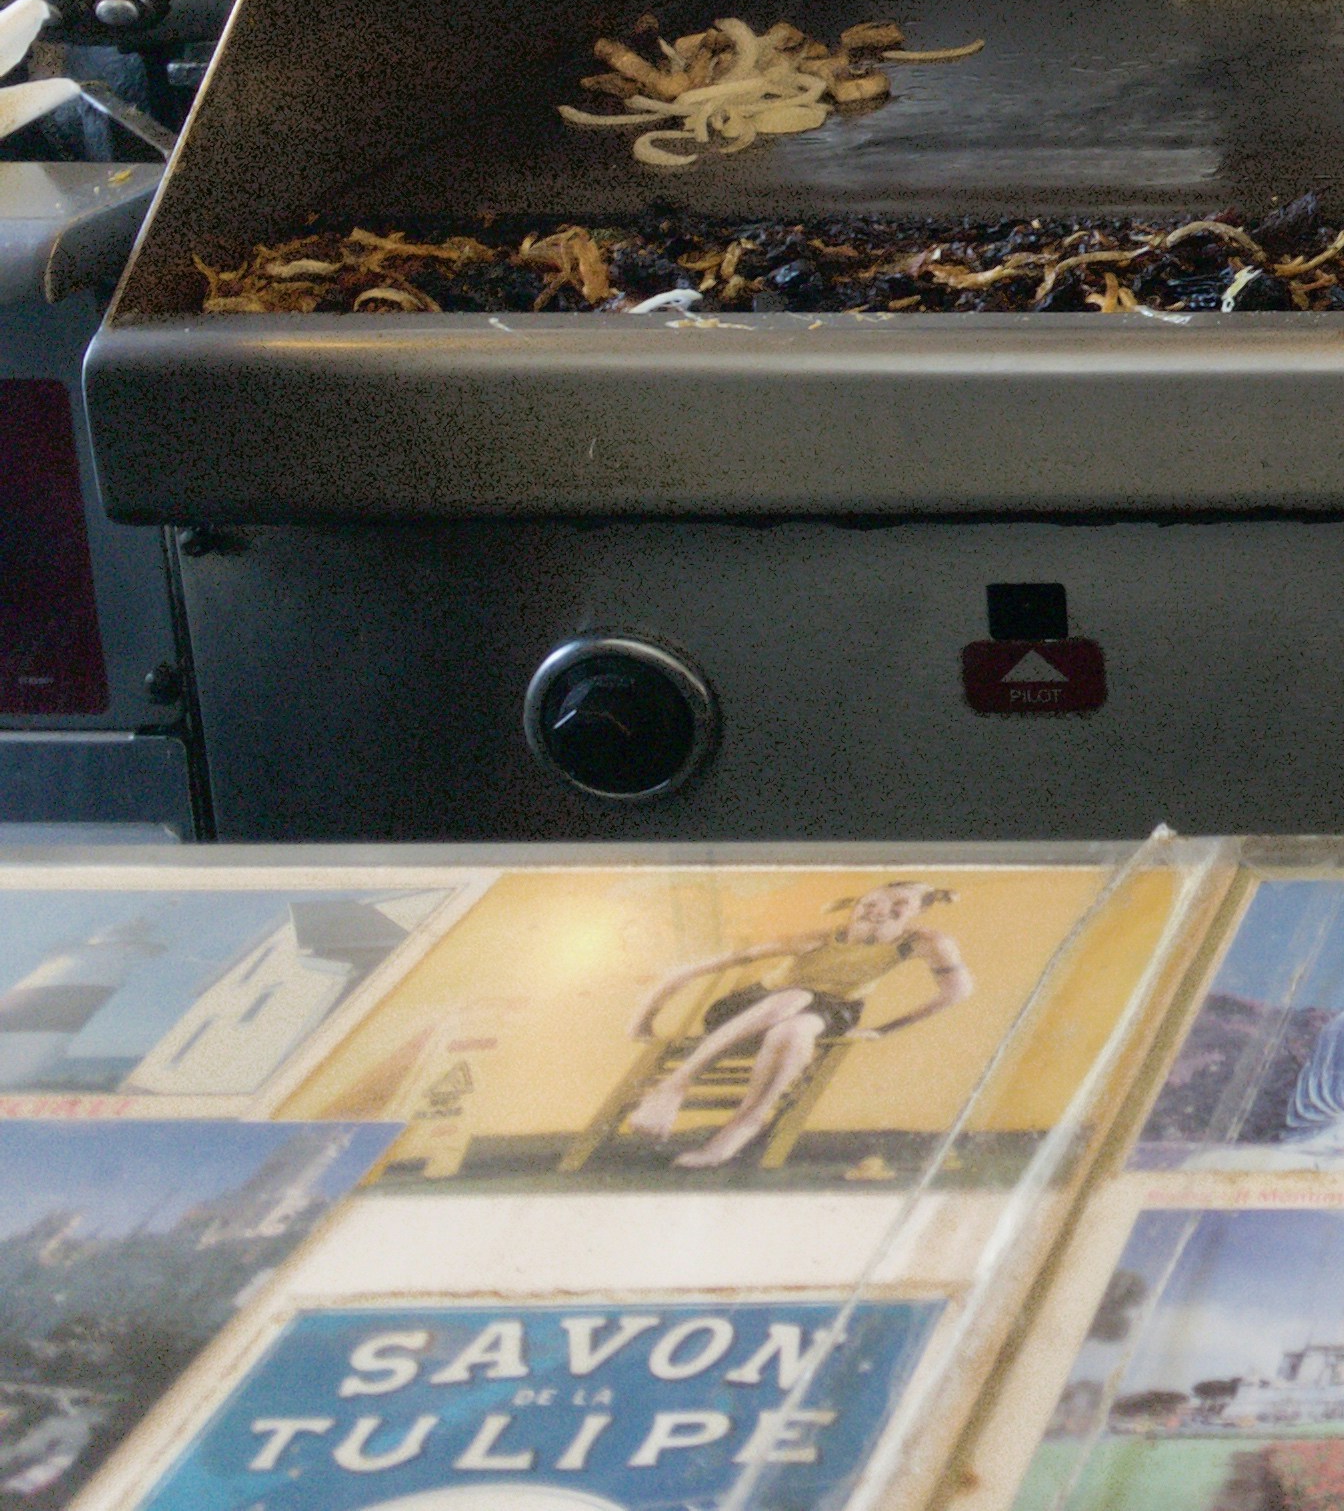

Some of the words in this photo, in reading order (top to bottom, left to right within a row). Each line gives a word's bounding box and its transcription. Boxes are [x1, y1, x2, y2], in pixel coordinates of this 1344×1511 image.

[1010, 688, 1063, 704] PILOT
[337, 1315, 848, 1397] SAVON
[511, 1389, 559, 1406] DE
[572, 1388, 614, 1406] LA
[248, 1409, 838, 1472] TULIPE
